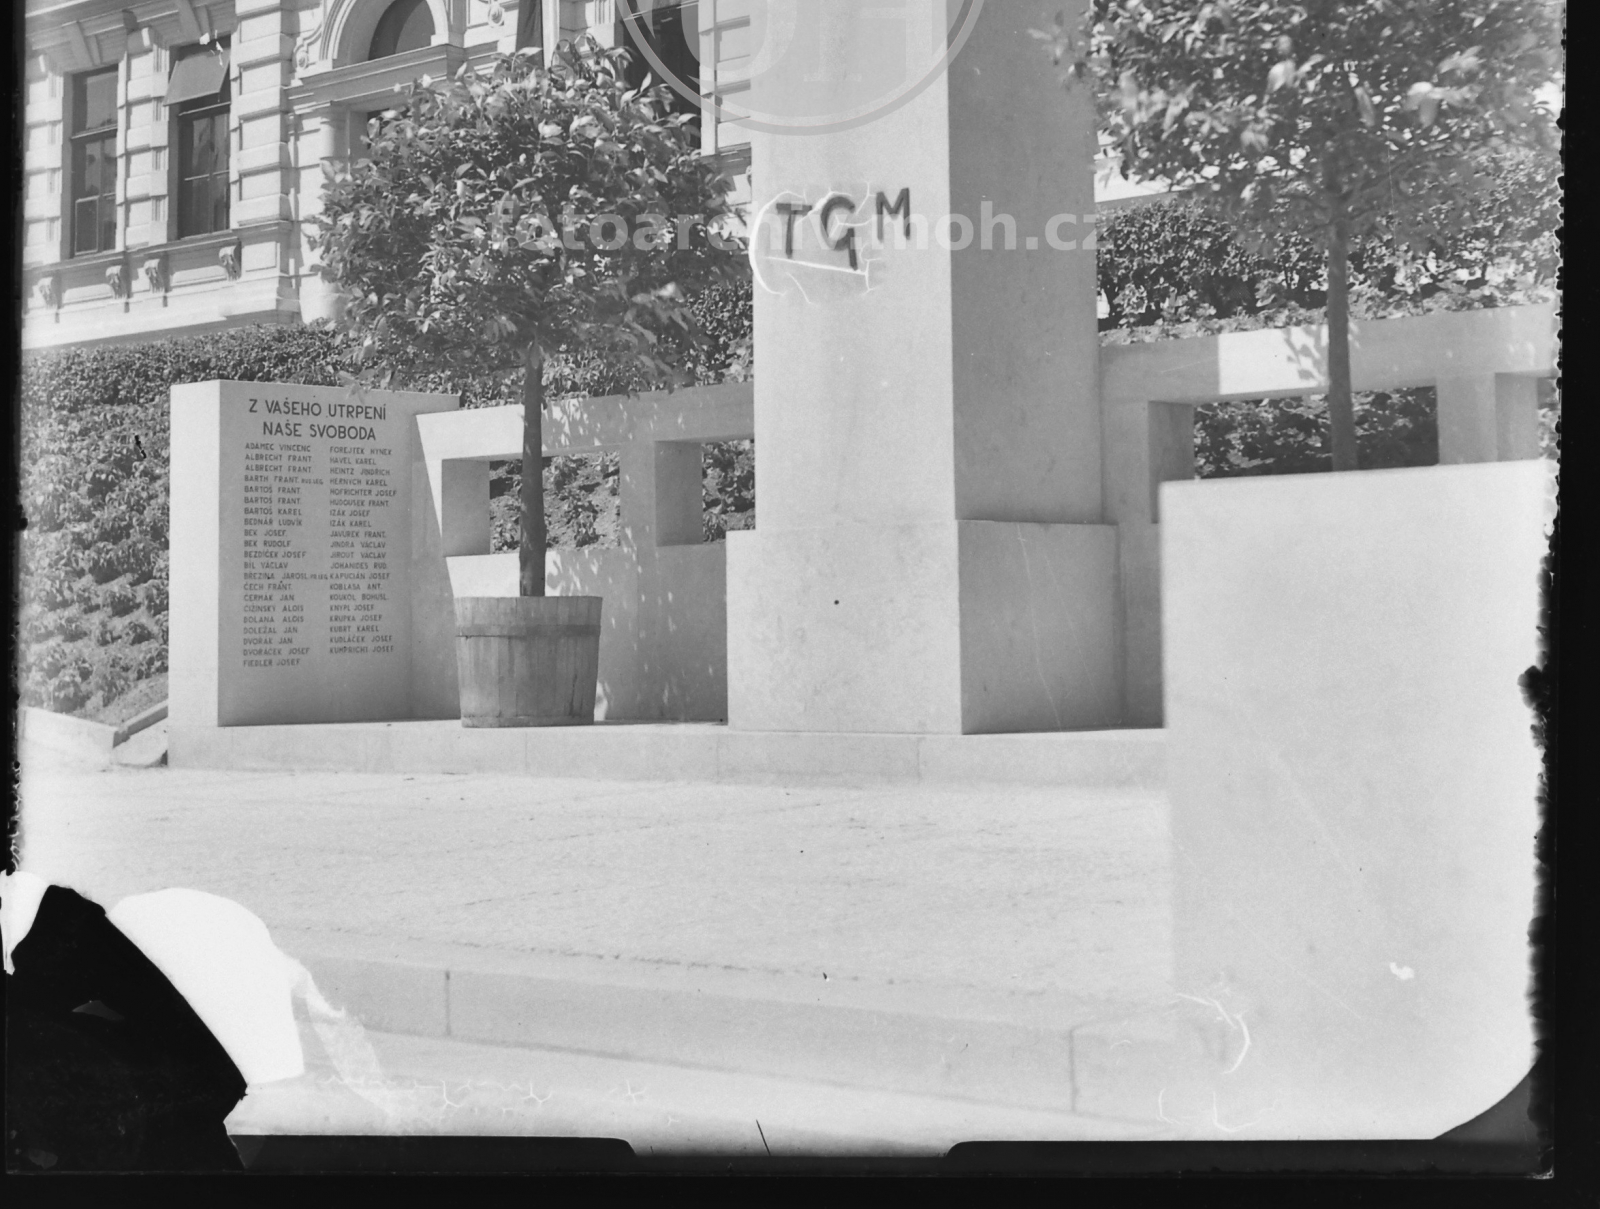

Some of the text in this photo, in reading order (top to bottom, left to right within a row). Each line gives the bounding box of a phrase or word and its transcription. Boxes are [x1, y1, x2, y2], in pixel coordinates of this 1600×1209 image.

[775, 186, 911, 272] TGM
[249, 397, 386, 420] Z VAŠEHO UTRPENÍ
[263, 419, 376, 441] NAŠE SVOBODA
[279, 444, 311, 452] VINCENC
[245, 453, 282, 461] ALBRECHT
[245, 464, 282, 472] ALBRECHT
[244, 484, 273, 493] BARTOŠ
[244, 495, 273, 504] BARTOŠ
[244, 506, 302, 516] BARTOŠ KAREL
[372, 645, 394, 653] JOSEF
